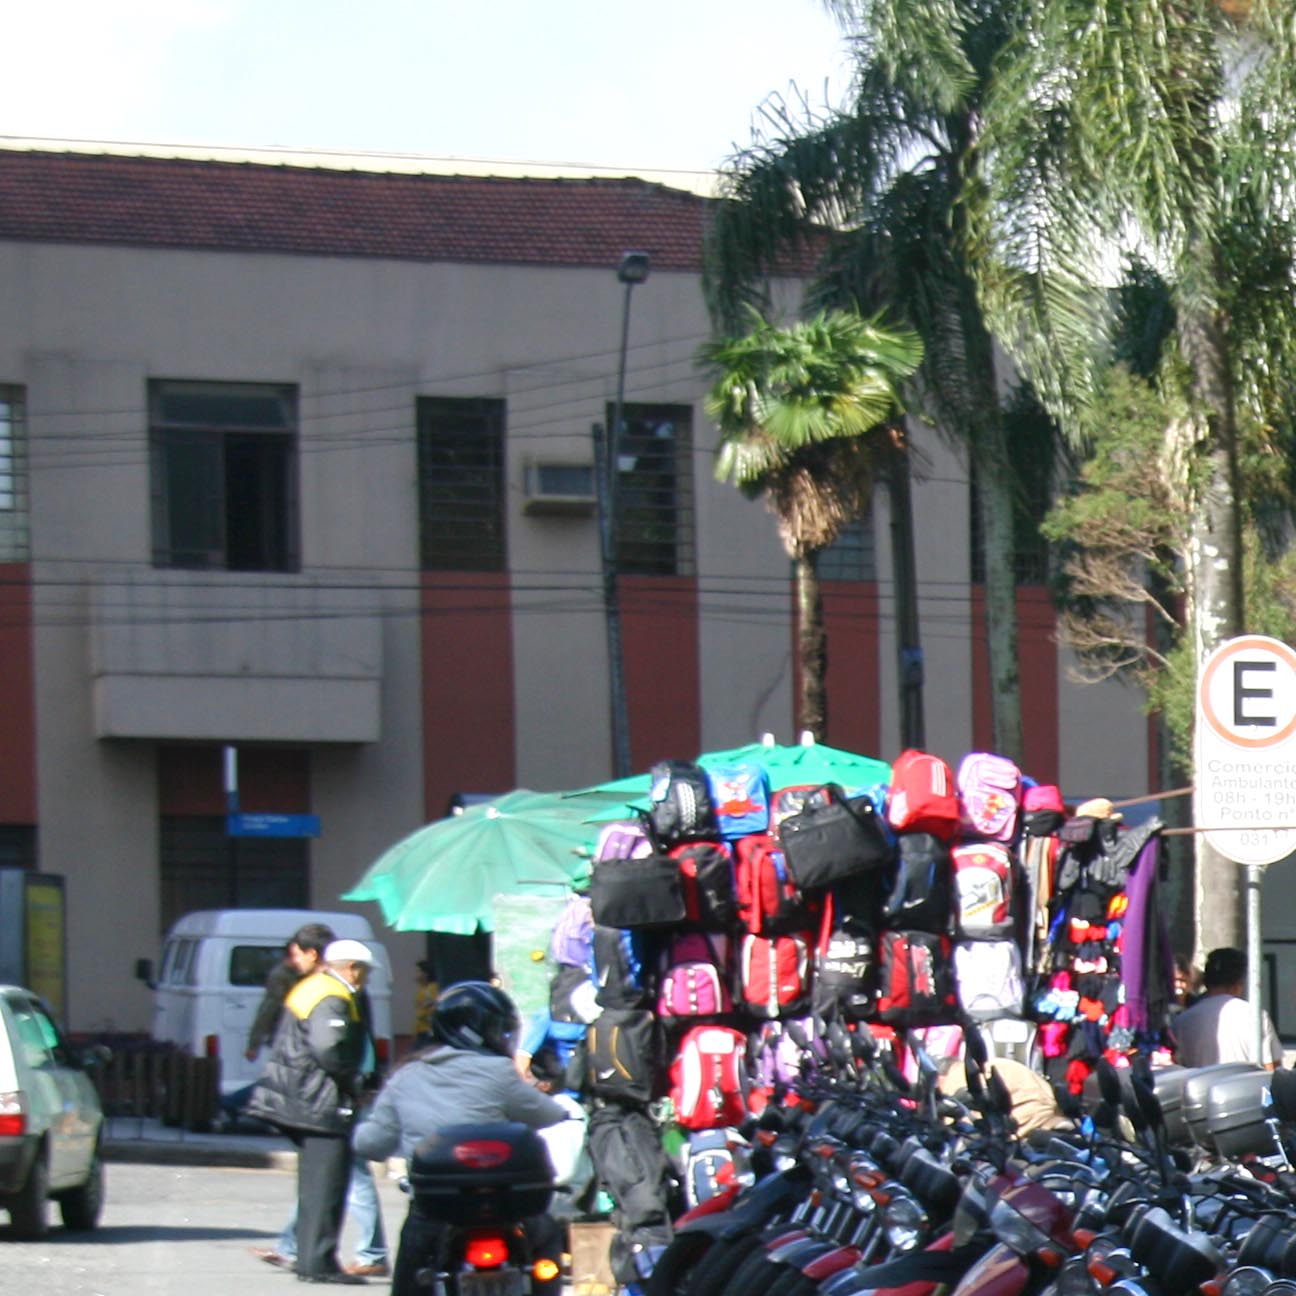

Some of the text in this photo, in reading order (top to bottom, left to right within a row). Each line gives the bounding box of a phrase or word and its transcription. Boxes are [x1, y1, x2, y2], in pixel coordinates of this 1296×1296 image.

[1233, 661, 1277, 727] E
[1213, 791, 1246, 804] 08h
[1264, 791, 1296, 805] 19h
[1220, 806, 1273, 821] Ponto
